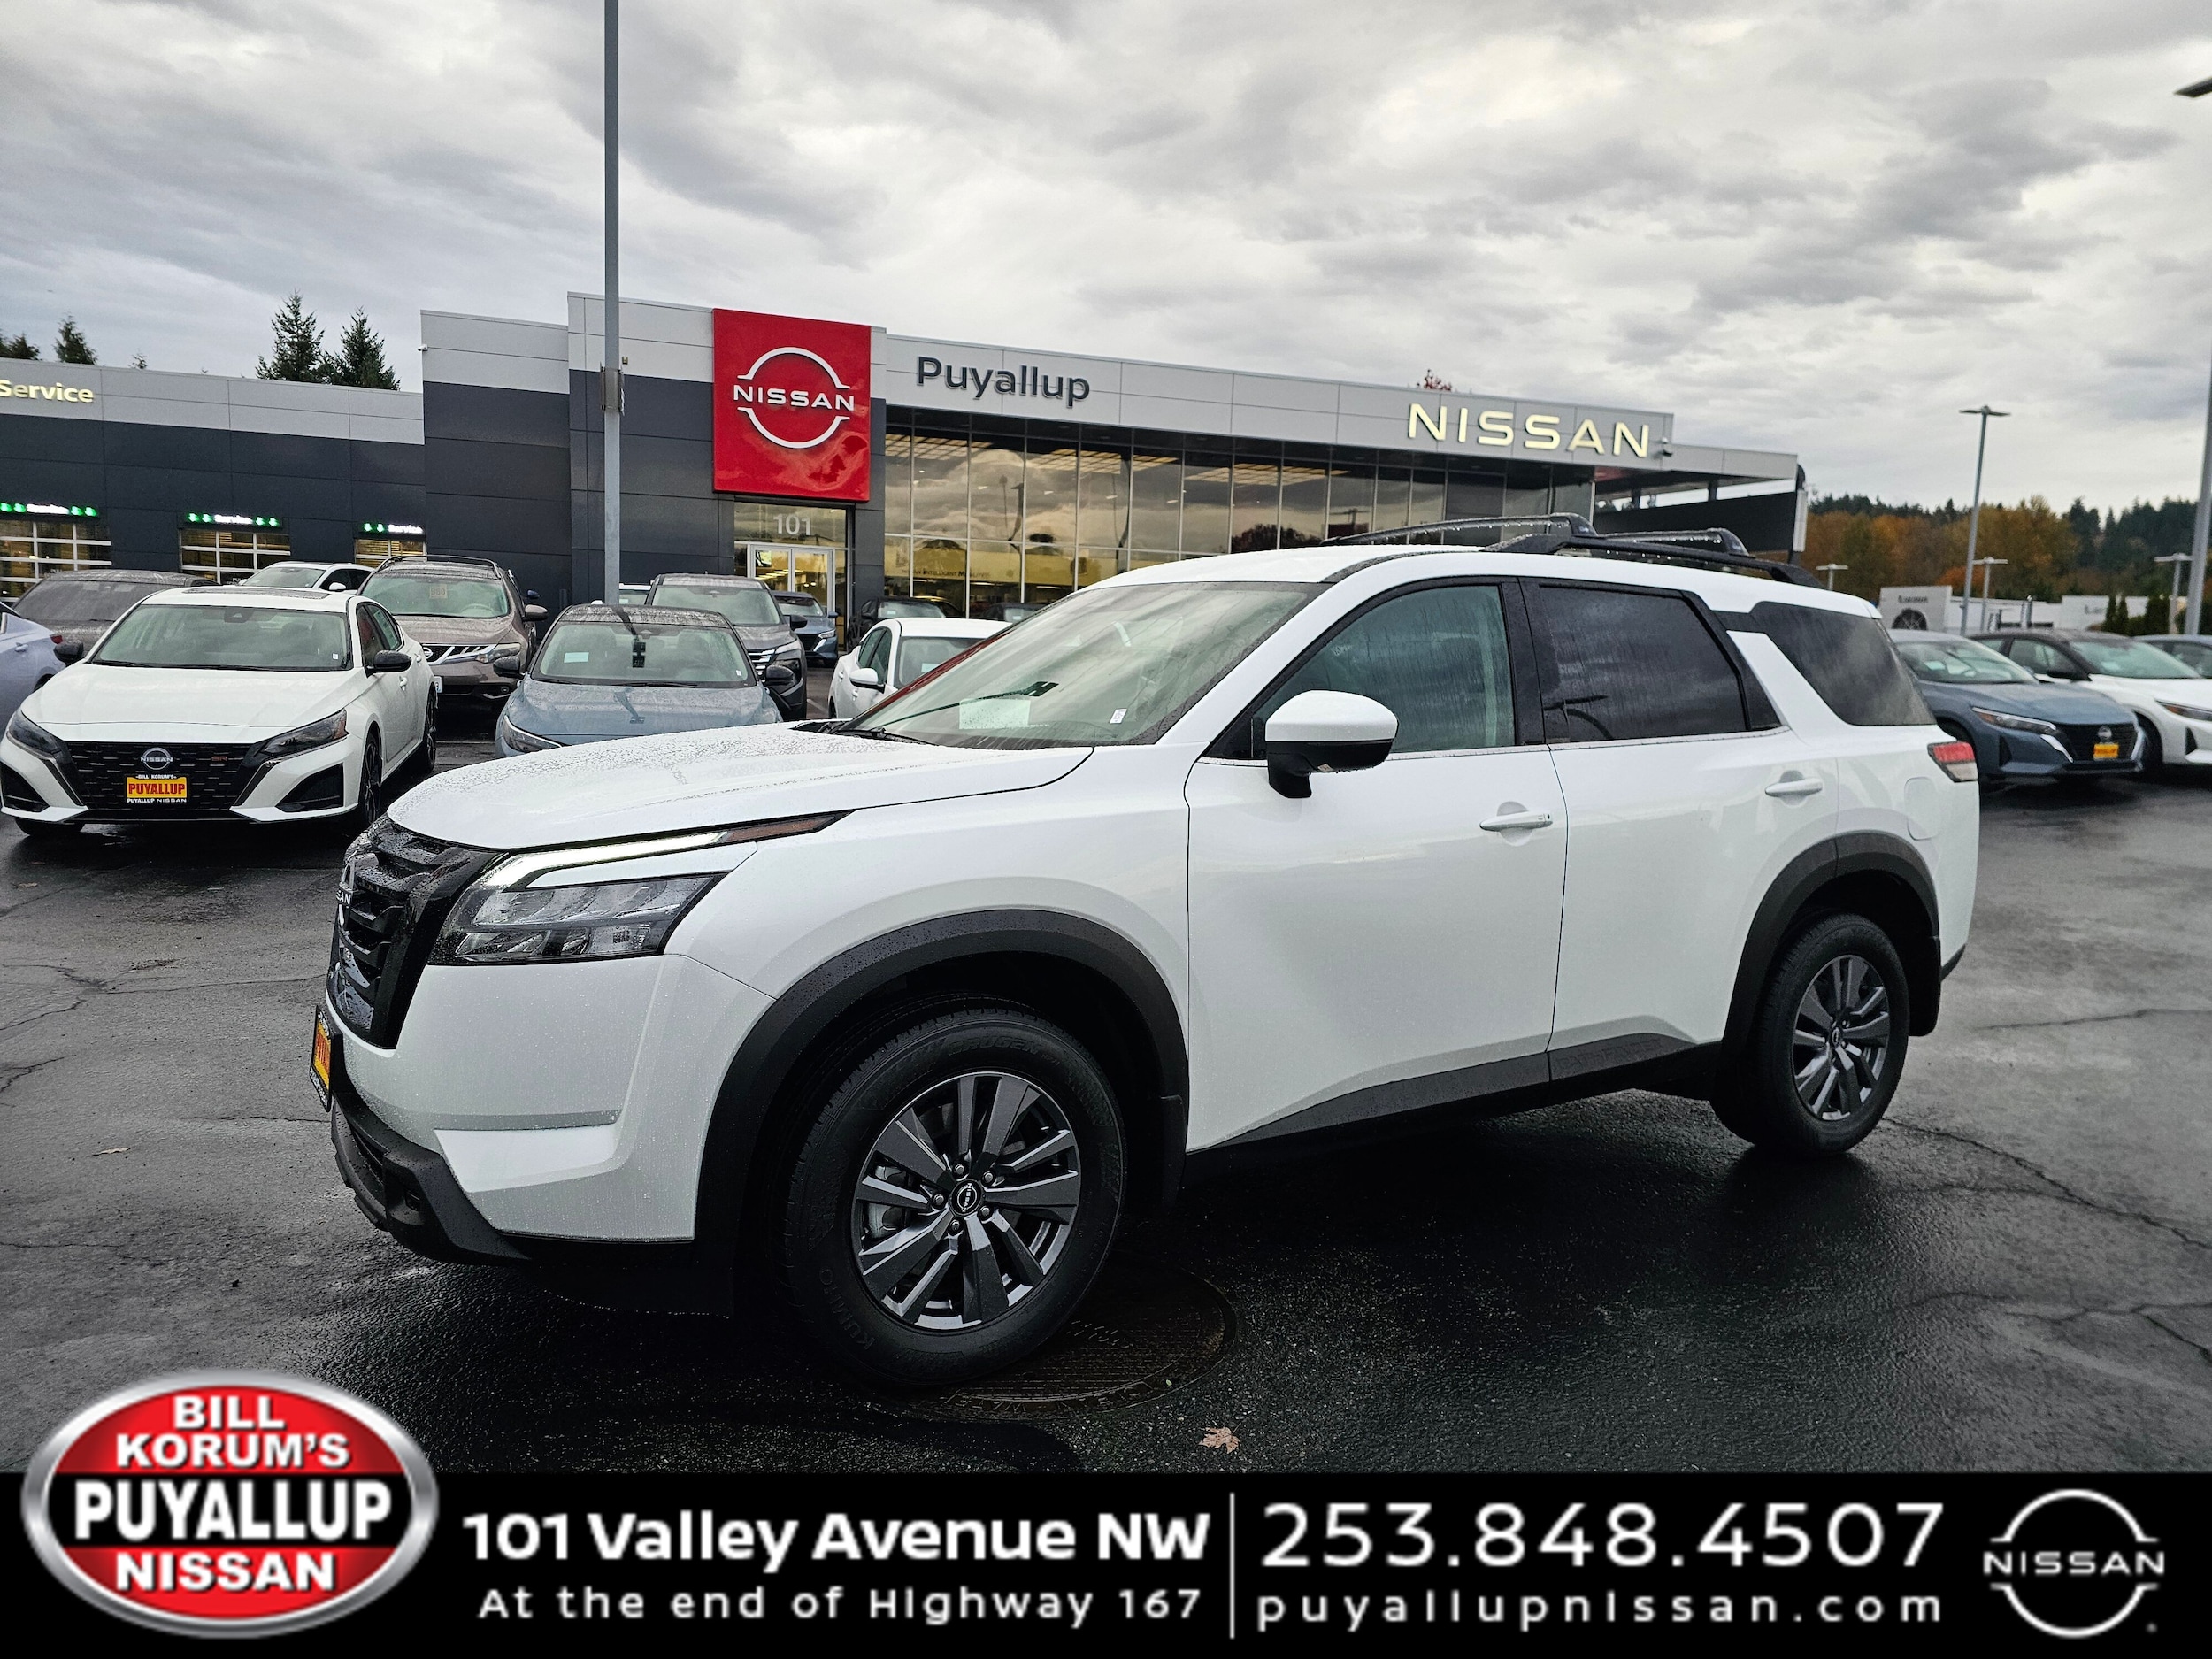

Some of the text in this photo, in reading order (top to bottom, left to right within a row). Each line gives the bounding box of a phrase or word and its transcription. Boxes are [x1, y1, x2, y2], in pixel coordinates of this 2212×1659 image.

[0, 379, 94, 403] Service
[917, 356, 1090, 408] Puyallup
[733, 384, 855, 412] NISSAN
[1408, 403, 1650, 458] NISSAN
[773, 513, 812, 537] 101
[128, 783, 186, 795] PUYALLUP
